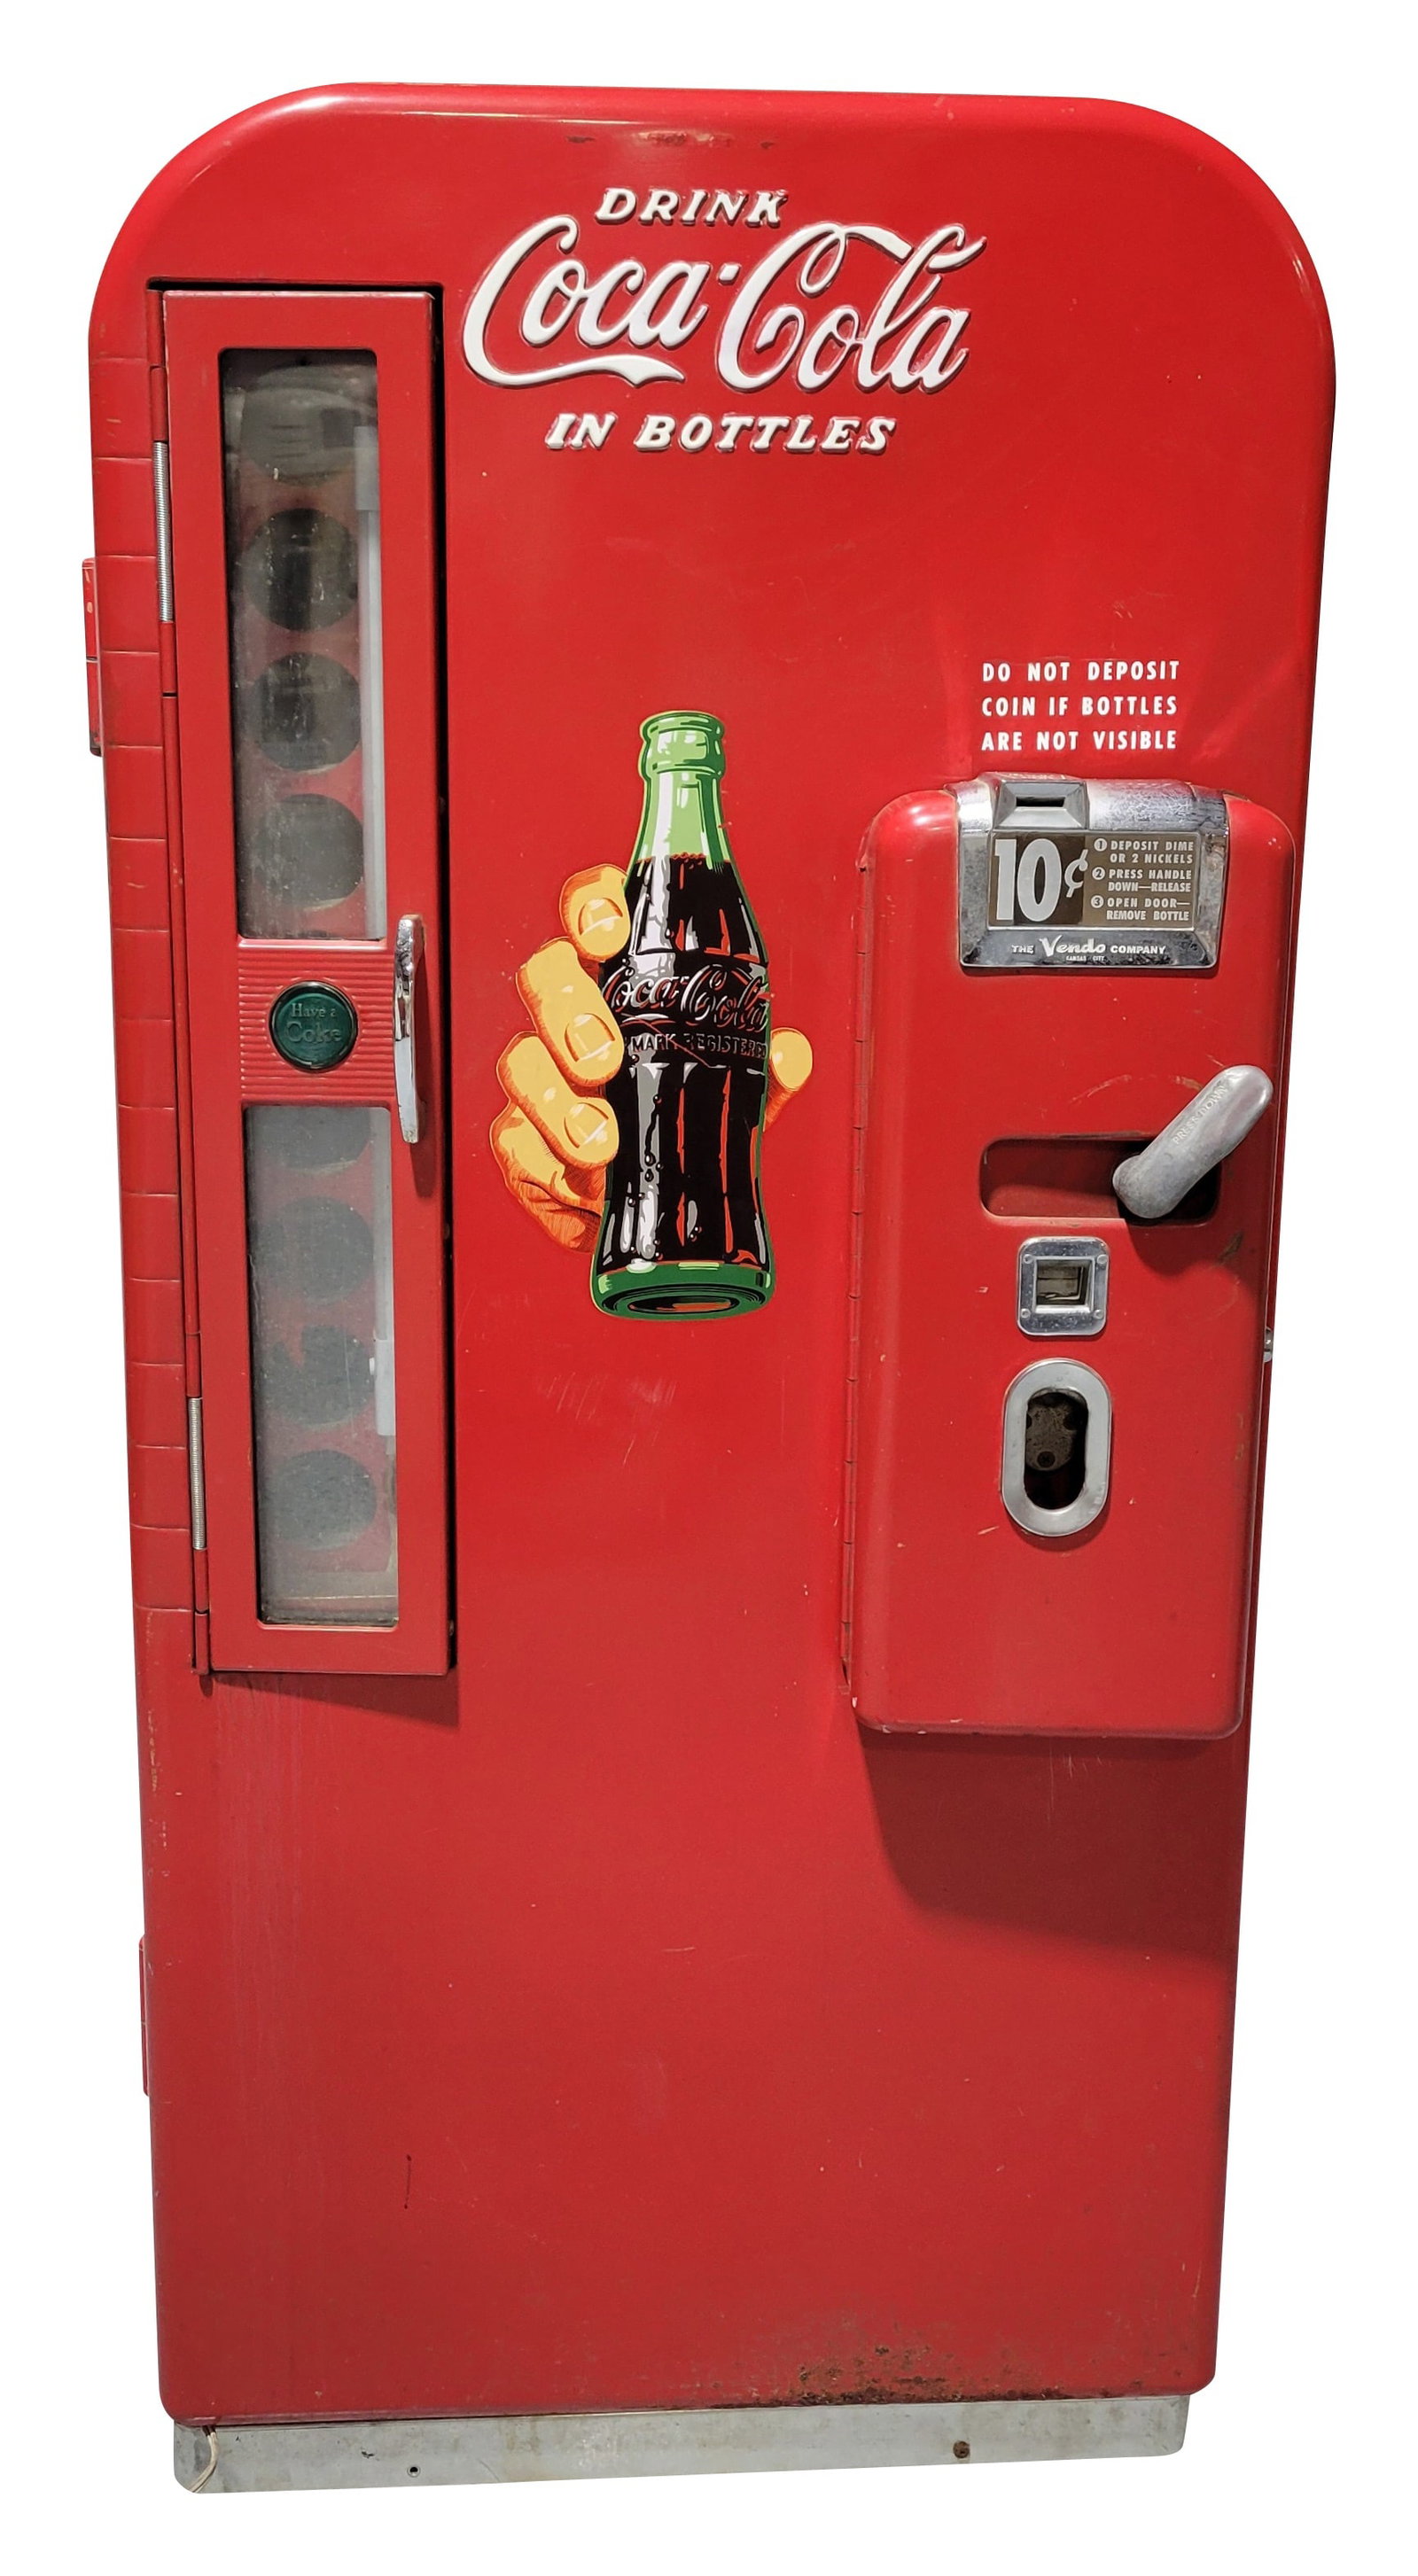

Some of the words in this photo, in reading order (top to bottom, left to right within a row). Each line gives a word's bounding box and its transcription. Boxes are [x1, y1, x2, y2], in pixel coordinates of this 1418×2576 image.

[595, 187, 788, 227] DRINK
[462, 214, 986, 393] Coca-Cola
[544, 413, 618, 451] IN
[634, 413, 896, 454] BOTTLES
[982, 663, 1011, 681] DO
[1028, 662, 1070, 681] NOT
[1087, 660, 1180, 681] DEPOSIT
[982, 697, 1036, 717] COIN
[1049, 697, 1069, 716] IF
[1081, 696, 1177, 716] BOTTLES
[981, 732, 1022, 751] ARE
[1036, 731, 1079, 751] NOT
[1093, 730, 1177, 750] VISIBLE
[1110, 841, 1159, 851] DEPOSIT
[1165, 841, 1194, 851] DIME
[1110, 853, 1126, 863] OR
[1132, 853, 1139, 863] 2
[1144, 853, 1193, 863] NICKELS
[1109, 869, 1143, 879] PRESS
[1149, 869, 1192, 879] HANDLE
[1107, 898, 1138, 907] OPEN
[1106, 910, 1146, 920] REMOVE
[1153, 911, 1189, 921] BOTTLE
[1011, 945, 1034, 954] THE
[1039, 934, 1106, 957] Vendo
[1110, 945, 1166, 954] COMPANY
[291, 1002, 326, 1018] Have
[285, 1021, 342, 1044] Coke
[630, 1033, 676, 1053] MARK
